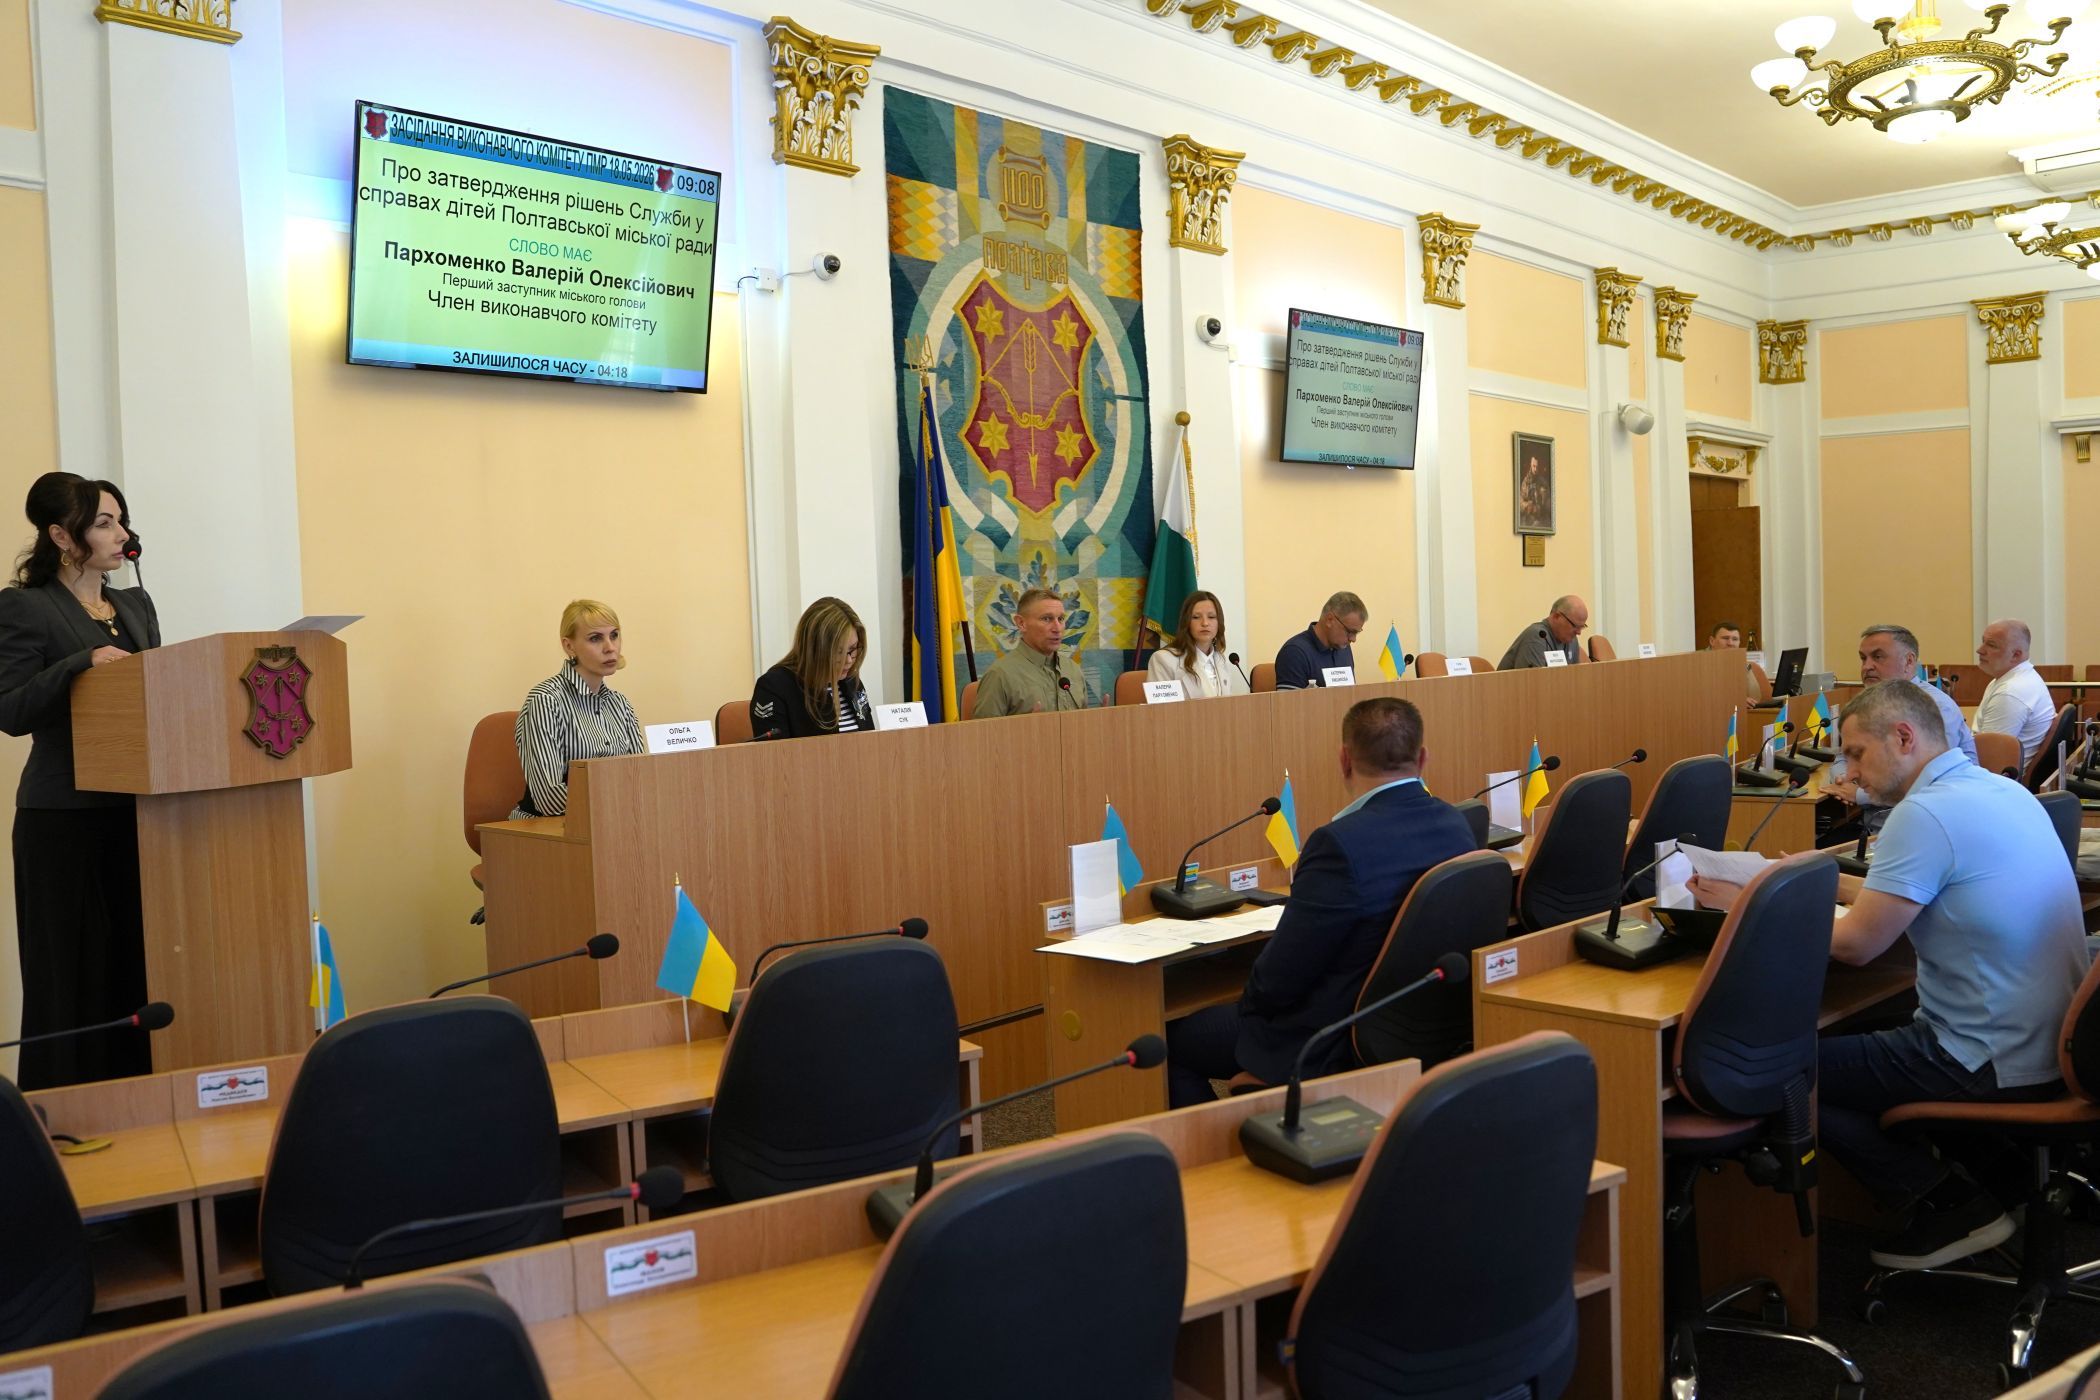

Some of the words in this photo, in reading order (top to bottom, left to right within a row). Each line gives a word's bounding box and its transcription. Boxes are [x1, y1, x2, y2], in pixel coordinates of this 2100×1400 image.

[390, 113, 455, 148] ЗАСІДАННЯ
[457, 127, 534, 163] ВИКОНАВЧОГО
[536, 142, 585, 173] КОМІТЕТУ
[587, 152, 607, 177] ПМР
[609, 157, 655, 186] 18.05.2026
[382, 158, 422, 187] Про
[427, 167, 560, 206] затвердження
[565, 190, 624, 218] рішень
[629, 201, 692, 230] Служби
[695, 217, 704, 234] у
[677, 175, 715, 196] 09:08
[359, 186, 441, 213] справах
[446, 197, 496, 224] дітей
[502, 205, 612, 239] Полтавської
[615, 225, 672, 249] міської
[676, 235, 713, 256] ради
[509, 238, 559, 258] СЛОВО
[563, 244, 593, 262] МАЄ
[384, 241, 506, 275] Пархоменко
[511, 257, 585, 286] Валерій
[589, 268, 695, 299] Олексійович
[442, 272, 494, 291] Перший
[497, 281, 556, 301] заступник
[559, 288, 606, 306] міського
[608, 296, 646, 310] голови
[428, 290, 475, 311] Член
[480, 300, 587, 325] виконавчого
[591, 313, 658, 335] комітету
[453, 351, 550, 372] ЗАЛИШИЛОСЯ
[553, 359, 587, 375] ЧАСУ
[597, 364, 628, 379] 04:18
[1297, 339, 1312, 352] Про
[1313, 343, 1363, 361] затвердження
[1364, 351, 1387, 365] рішень
[1388, 354, 1413, 369] Служби
[1289, 356, 1318, 369] справах
[1319, 361, 1338, 373] дітей
[1340, 362, 1381, 378] Полтавської
[1382, 370, 1405, 382] міської
[1296, 388, 1341, 405] Пархоменко
[1342, 394, 1370, 409] Валерій
[1372, 398, 1413, 413] Олексійович
[1311, 416, 1329, 429] Член
[1330, 421, 1370, 433] виконавчого
[1371, 425, 1397, 437] комітету
[666, 736, 697, 745] ВЕЛИЧКО
[669, 727, 691, 735] ОЛЬГА
